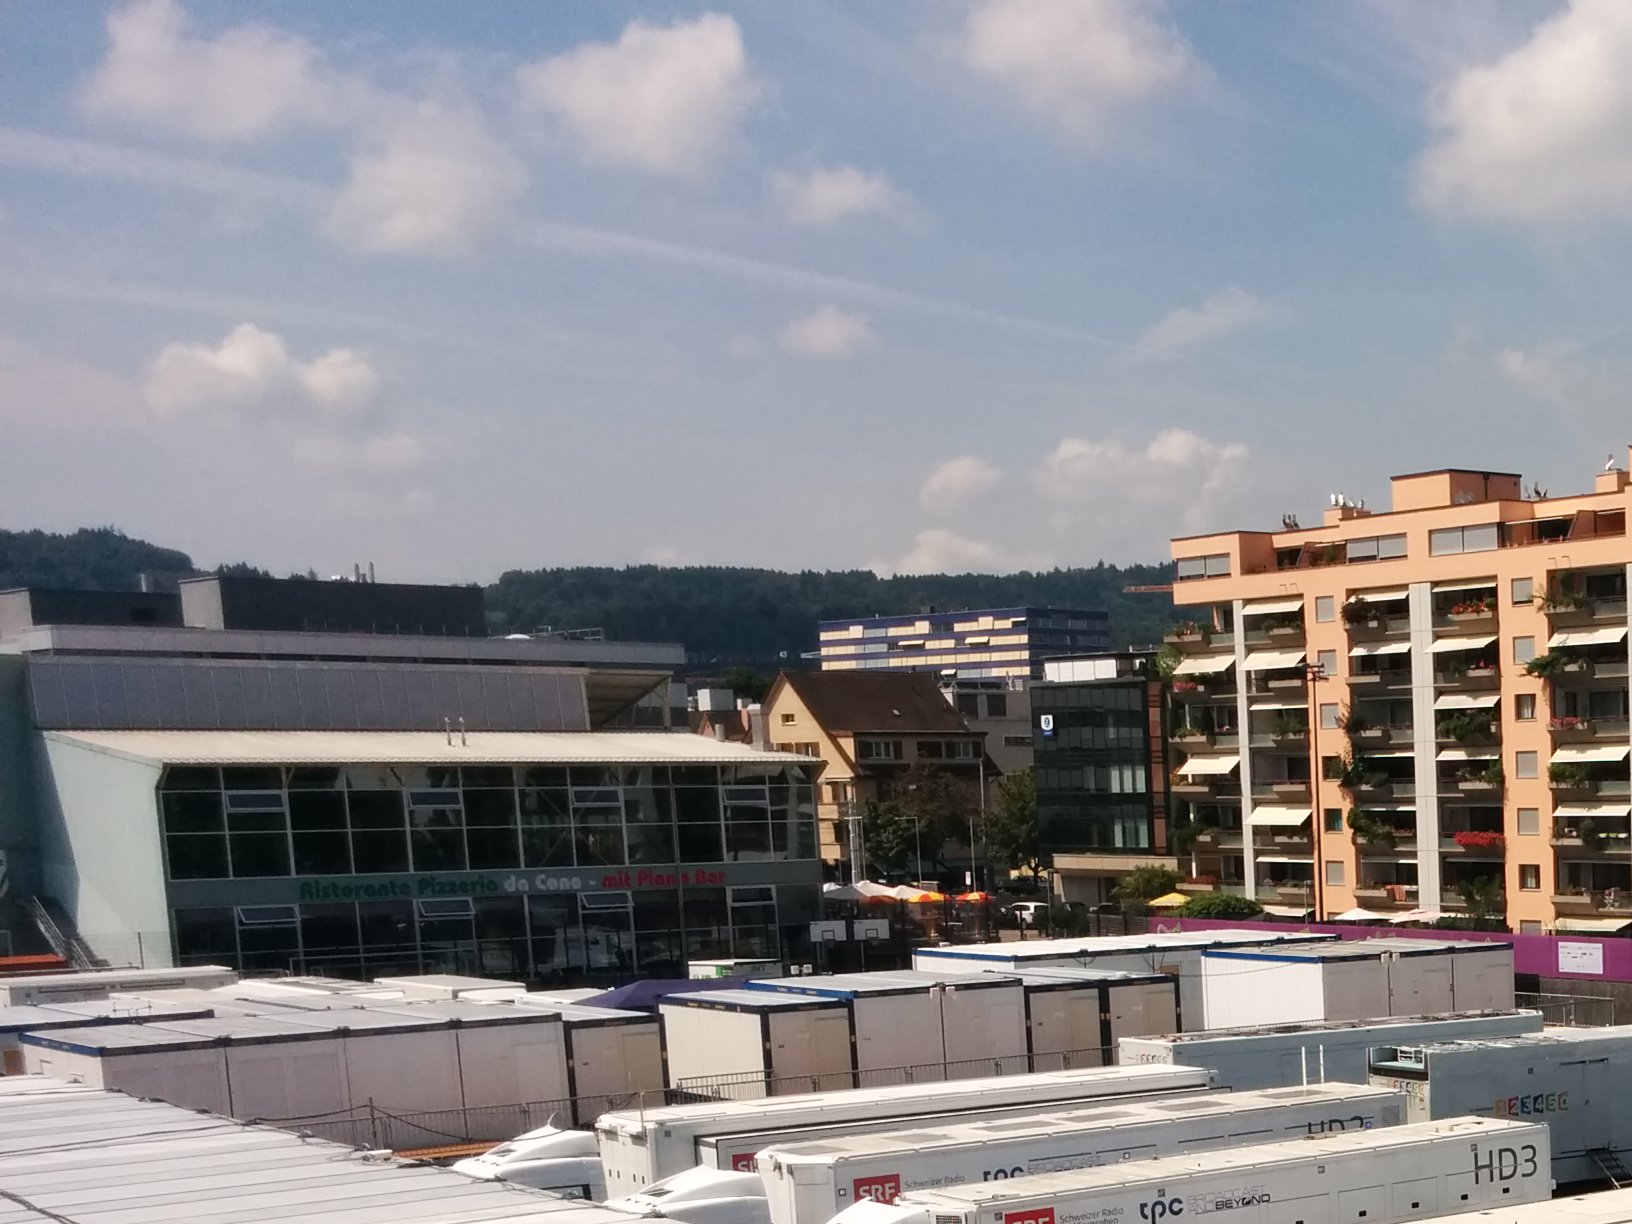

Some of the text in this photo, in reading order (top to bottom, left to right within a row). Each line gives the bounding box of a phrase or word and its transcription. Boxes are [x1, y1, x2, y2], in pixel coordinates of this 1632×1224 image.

[300, 879, 410, 899] Ristorante
[417, 875, 498, 896] Pizzeria
[503, 874, 529, 892] da
[601, 871, 631, 888] mit
[637, 869, 690, 886] Piano
[695, 868, 727, 884] Bar
[1473, 1144, 1538, 1185] HD3
[859, 1182, 896, 1200] SRF
[1059, 1206, 1124, 1224] Schweizer Radio
